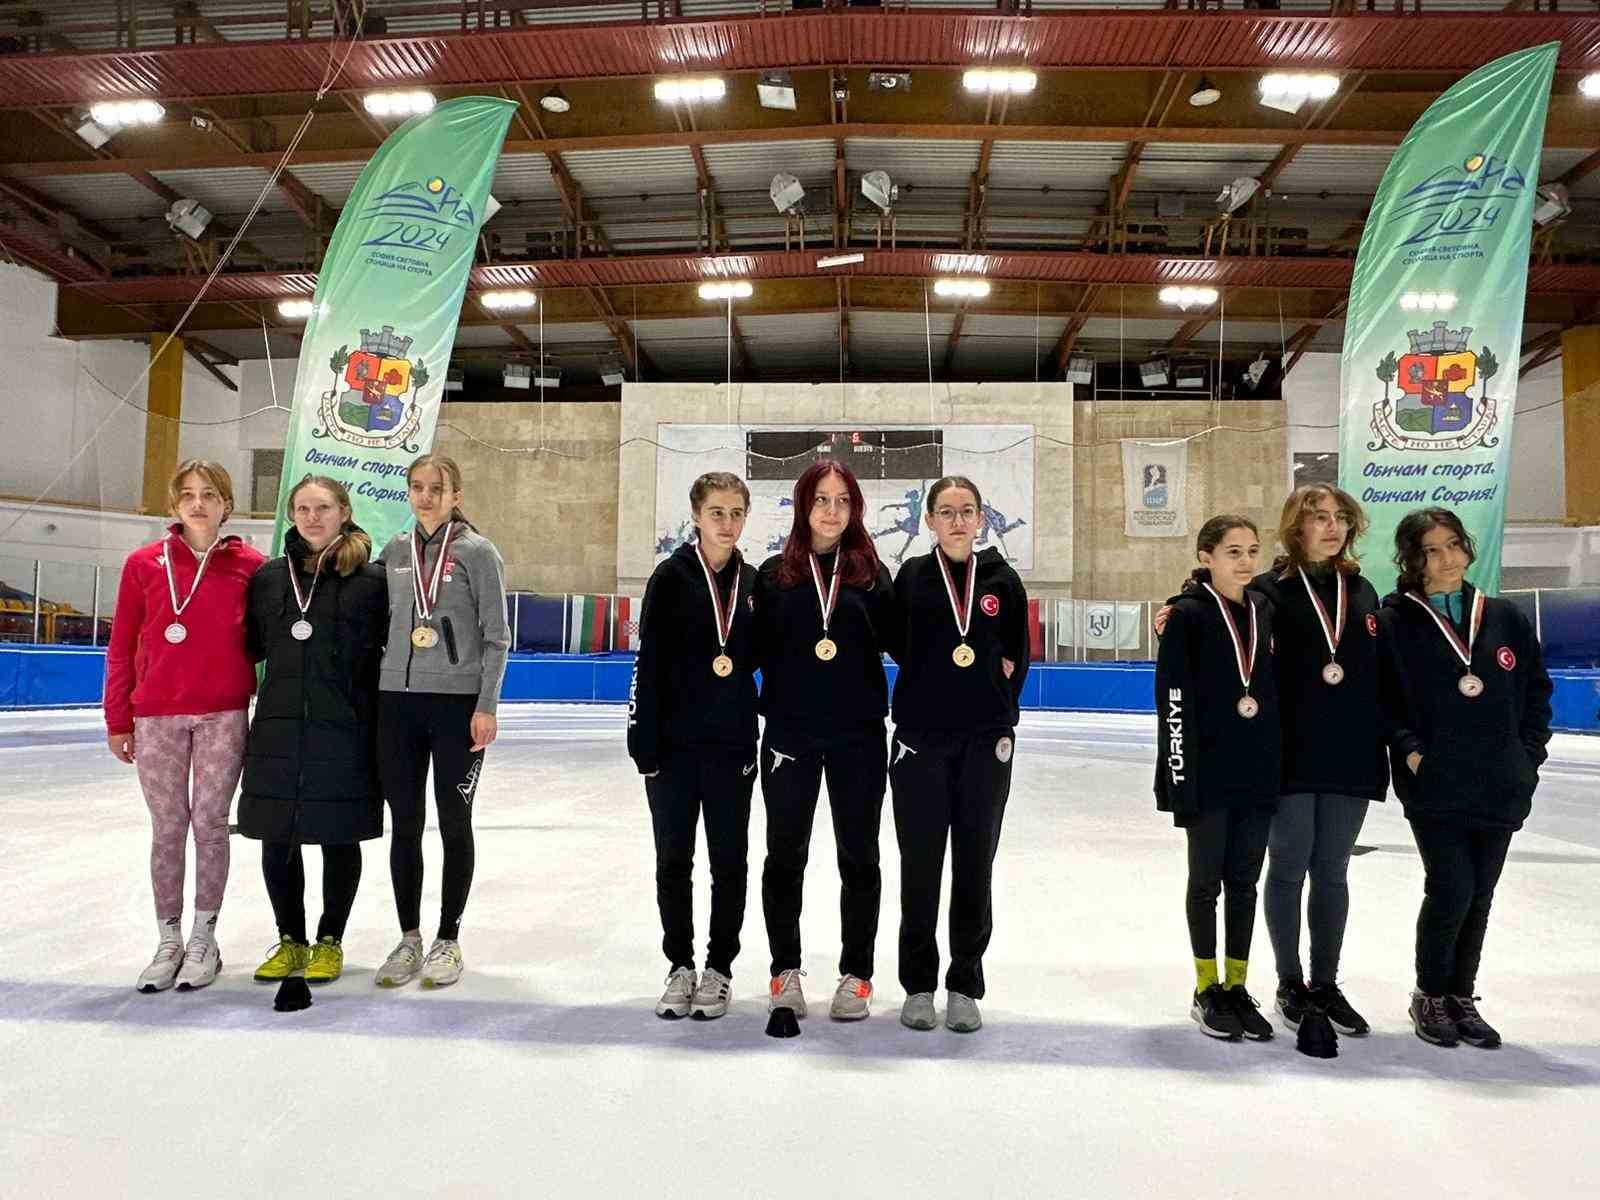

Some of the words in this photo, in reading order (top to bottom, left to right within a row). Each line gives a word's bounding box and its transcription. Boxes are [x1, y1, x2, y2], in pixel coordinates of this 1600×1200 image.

[361, 222, 451, 253] 2024
[1394, 207, 1501, 249] 2024
[305, 447, 359, 469] Обичам
[1362, 461, 1428, 478] Обичам
[1361, 486, 1427, 503] Обичам
[1431, 483, 1498, 506] София!
[1166, 686, 1186, 786] TÜRKİYE
